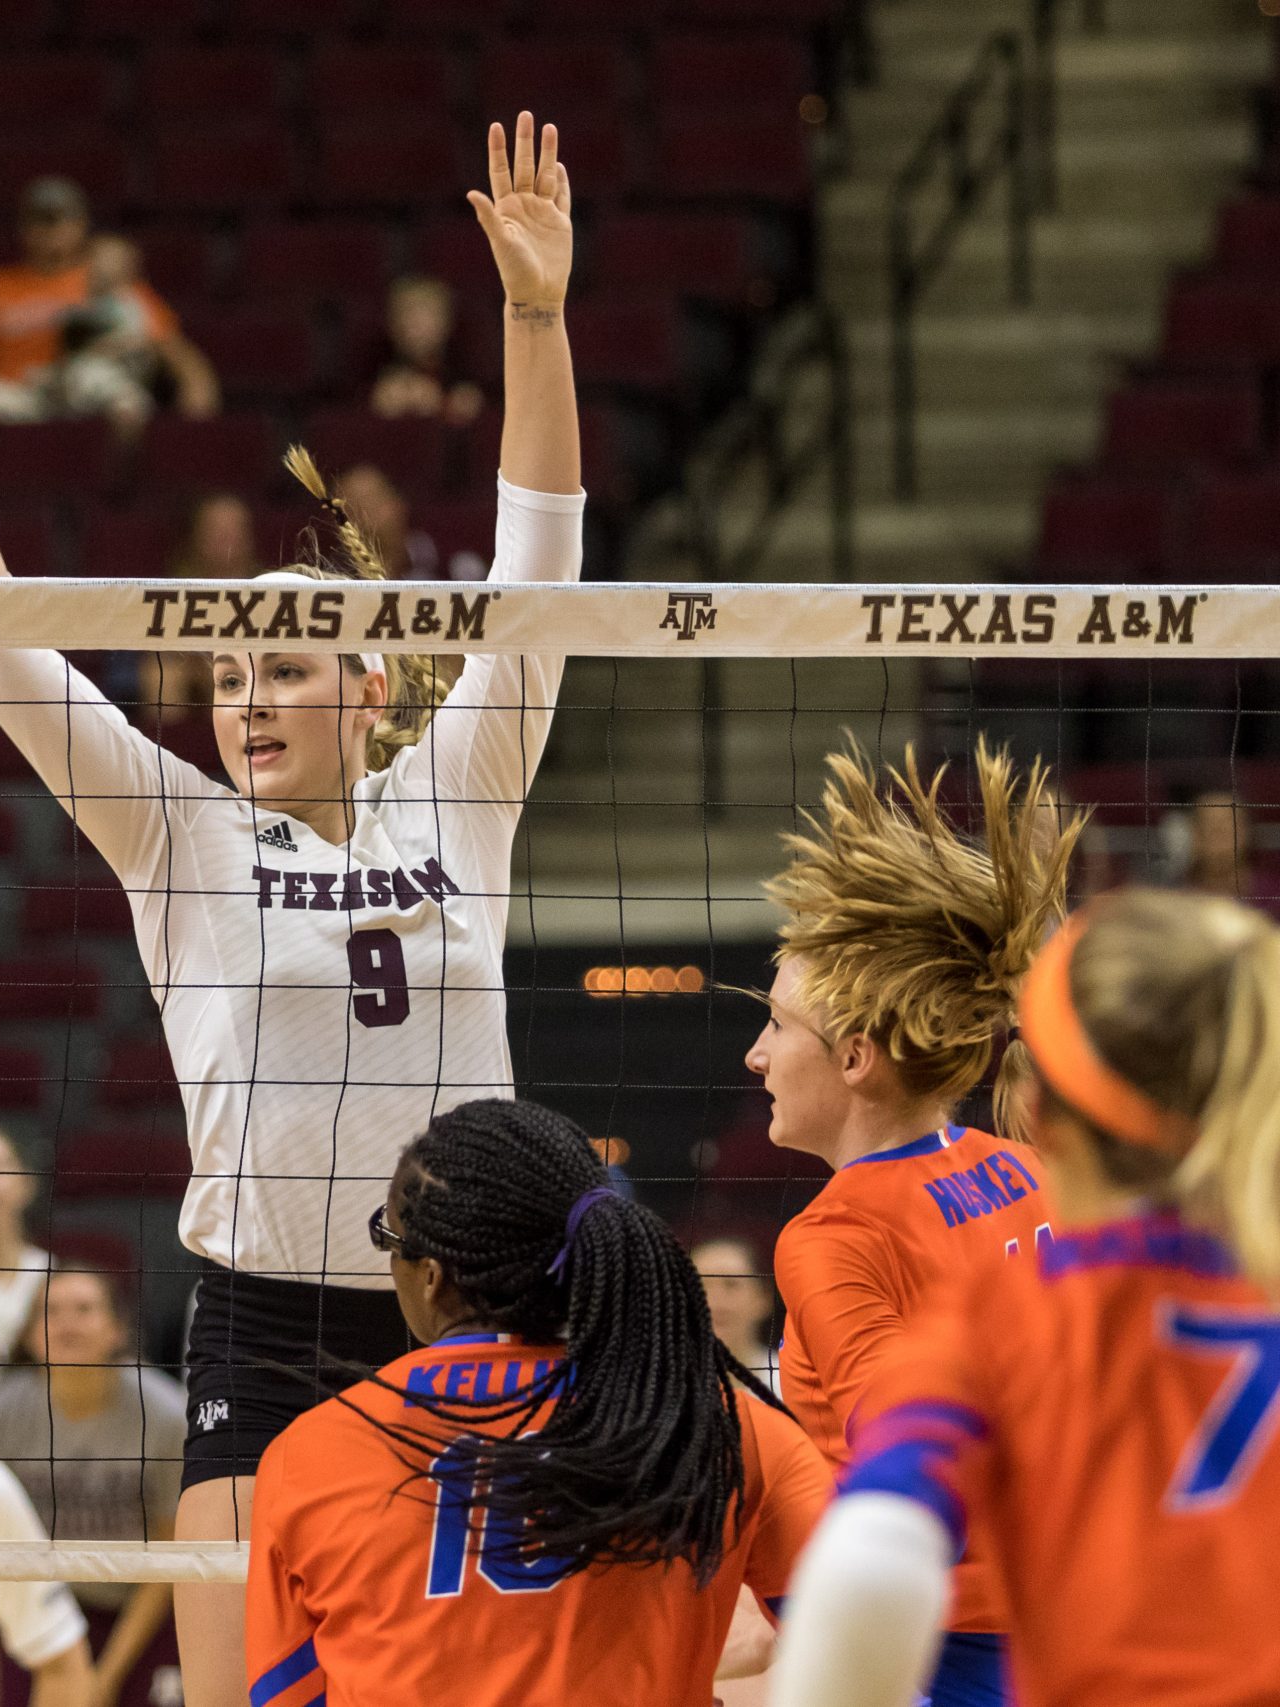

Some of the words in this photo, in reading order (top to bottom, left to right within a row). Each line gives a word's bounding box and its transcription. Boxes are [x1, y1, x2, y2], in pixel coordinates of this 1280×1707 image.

[142, 590, 345, 638] TEXAS
[860, 594, 1057, 643] TEXAS
[256, 833, 299, 853] adidas
[346, 928, 411, 1029] 9
[1152, 1300, 1280, 1518] 7
